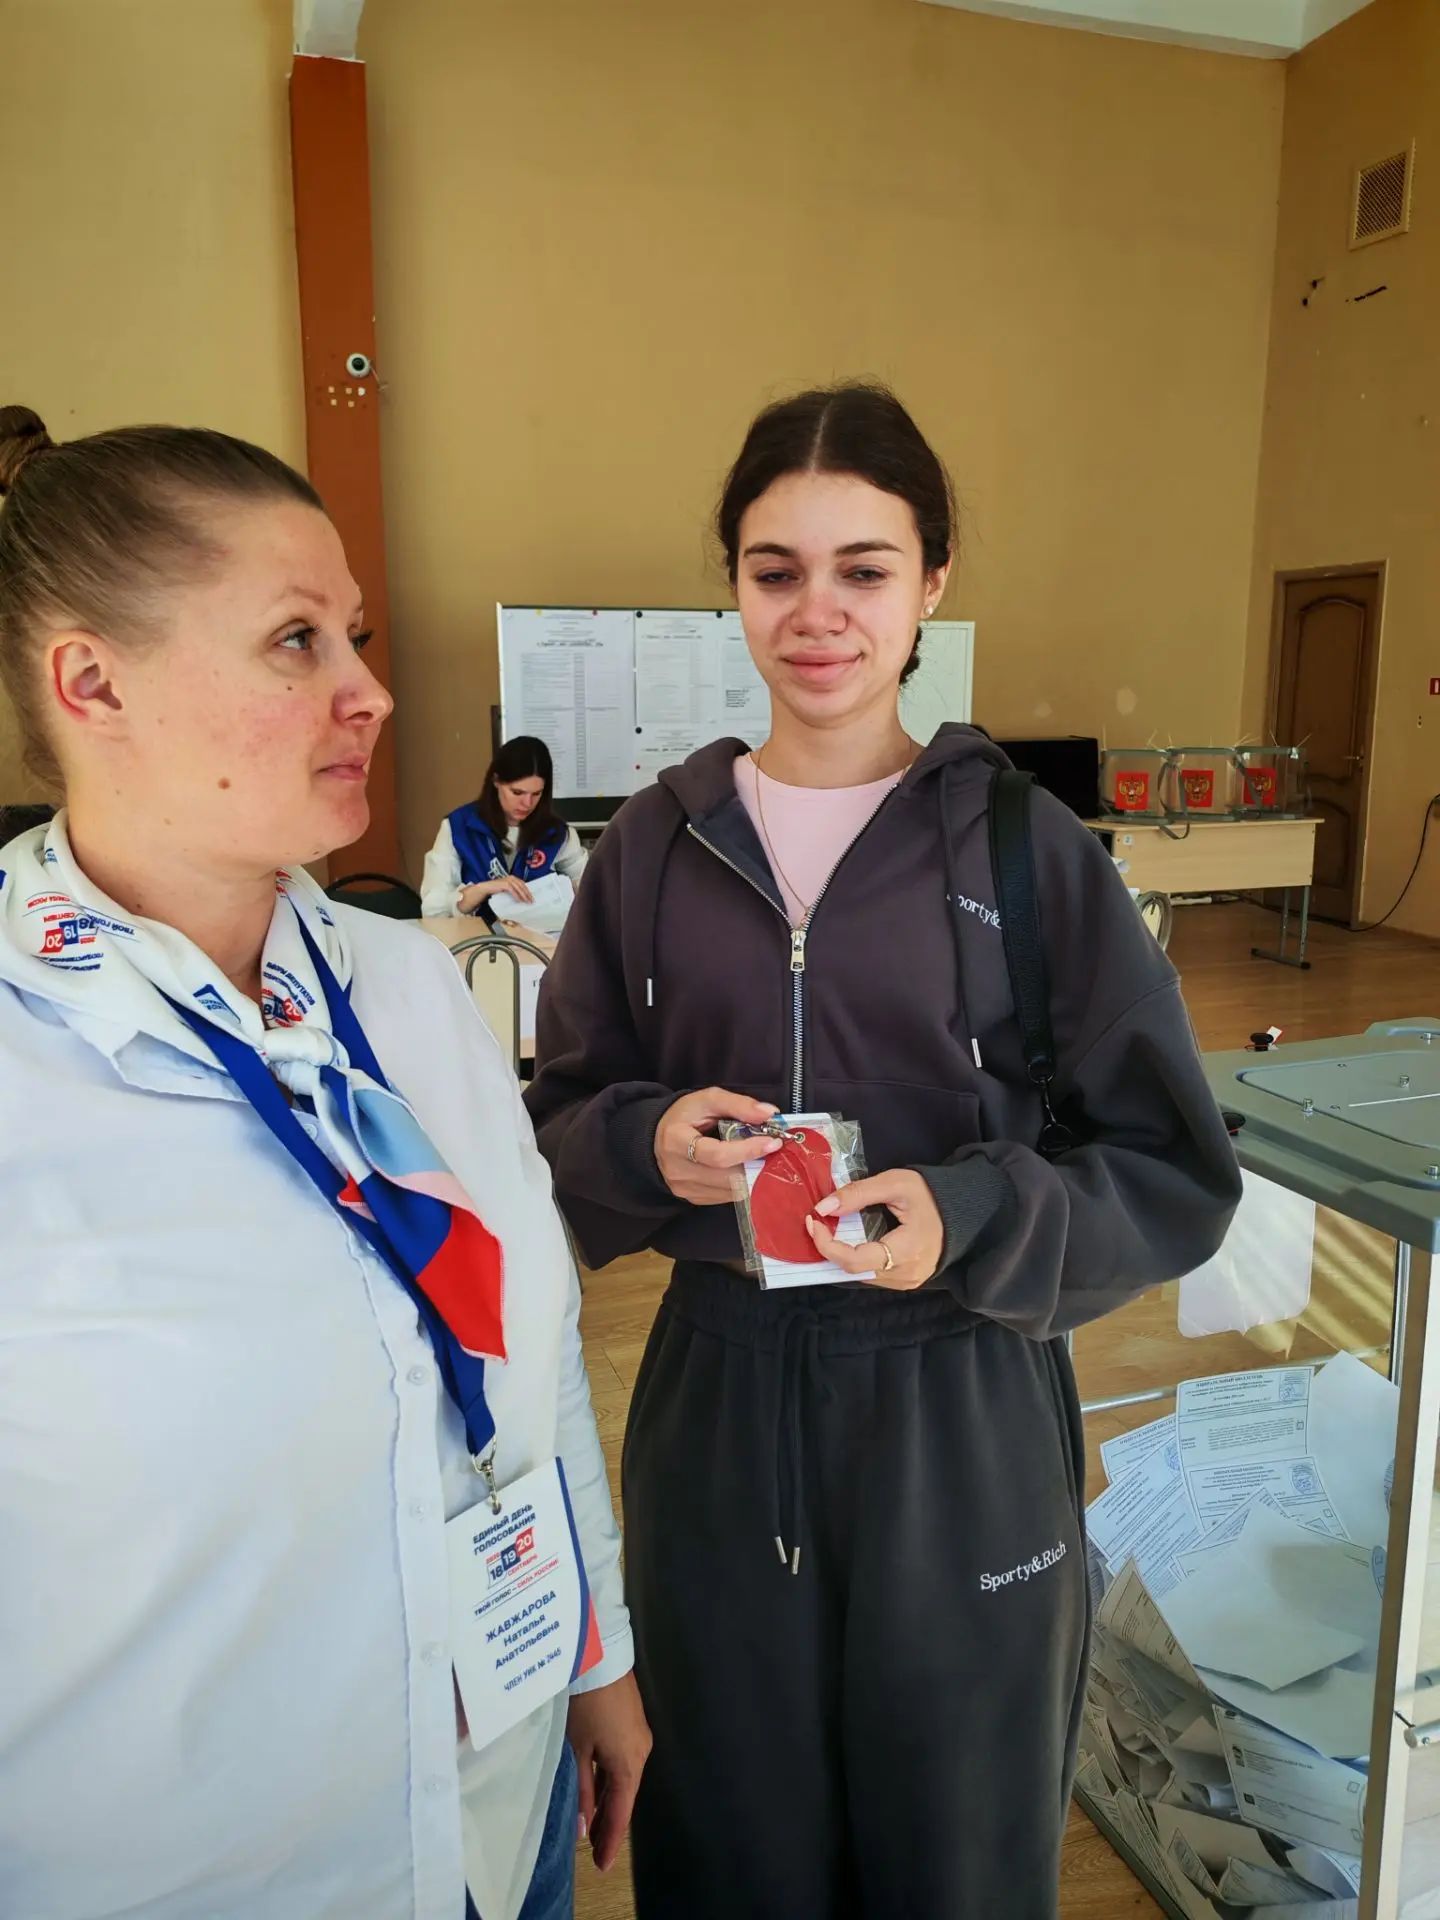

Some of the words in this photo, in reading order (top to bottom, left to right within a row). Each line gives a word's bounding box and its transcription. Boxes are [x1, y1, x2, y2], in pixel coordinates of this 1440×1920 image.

[46, 933, 63, 948] 20
[63, 924, 77, 940] 19
[111, 922, 135, 935] ТВОЙ
[472, 1515, 510, 1544] ЕДИНЫЙ
[511, 1504, 533, 1522] ДЕНЬ
[474, 1512, 536, 1556] ГОЛОСОВАНИЯ
[490, 1564, 504, 1581] 18
[502, 1549, 517, 1566] 19
[516, 1533, 532, 1551] 20
[979, 1541, 1067, 1592] Sporty&Rich
[474, 1602, 492, 1616] ТВОЙ
[491, 1588, 512, 1606] ГОЛОС
[485, 1589, 557, 1643] ЖАВЖАРОВА
[495, 1620, 560, 1670] Анатольевна
[503, 1613, 546, 1647] Наталья
[504, 1673, 523, 1692] ЧЛЕН
[523, 1664, 537, 1680] УИК
